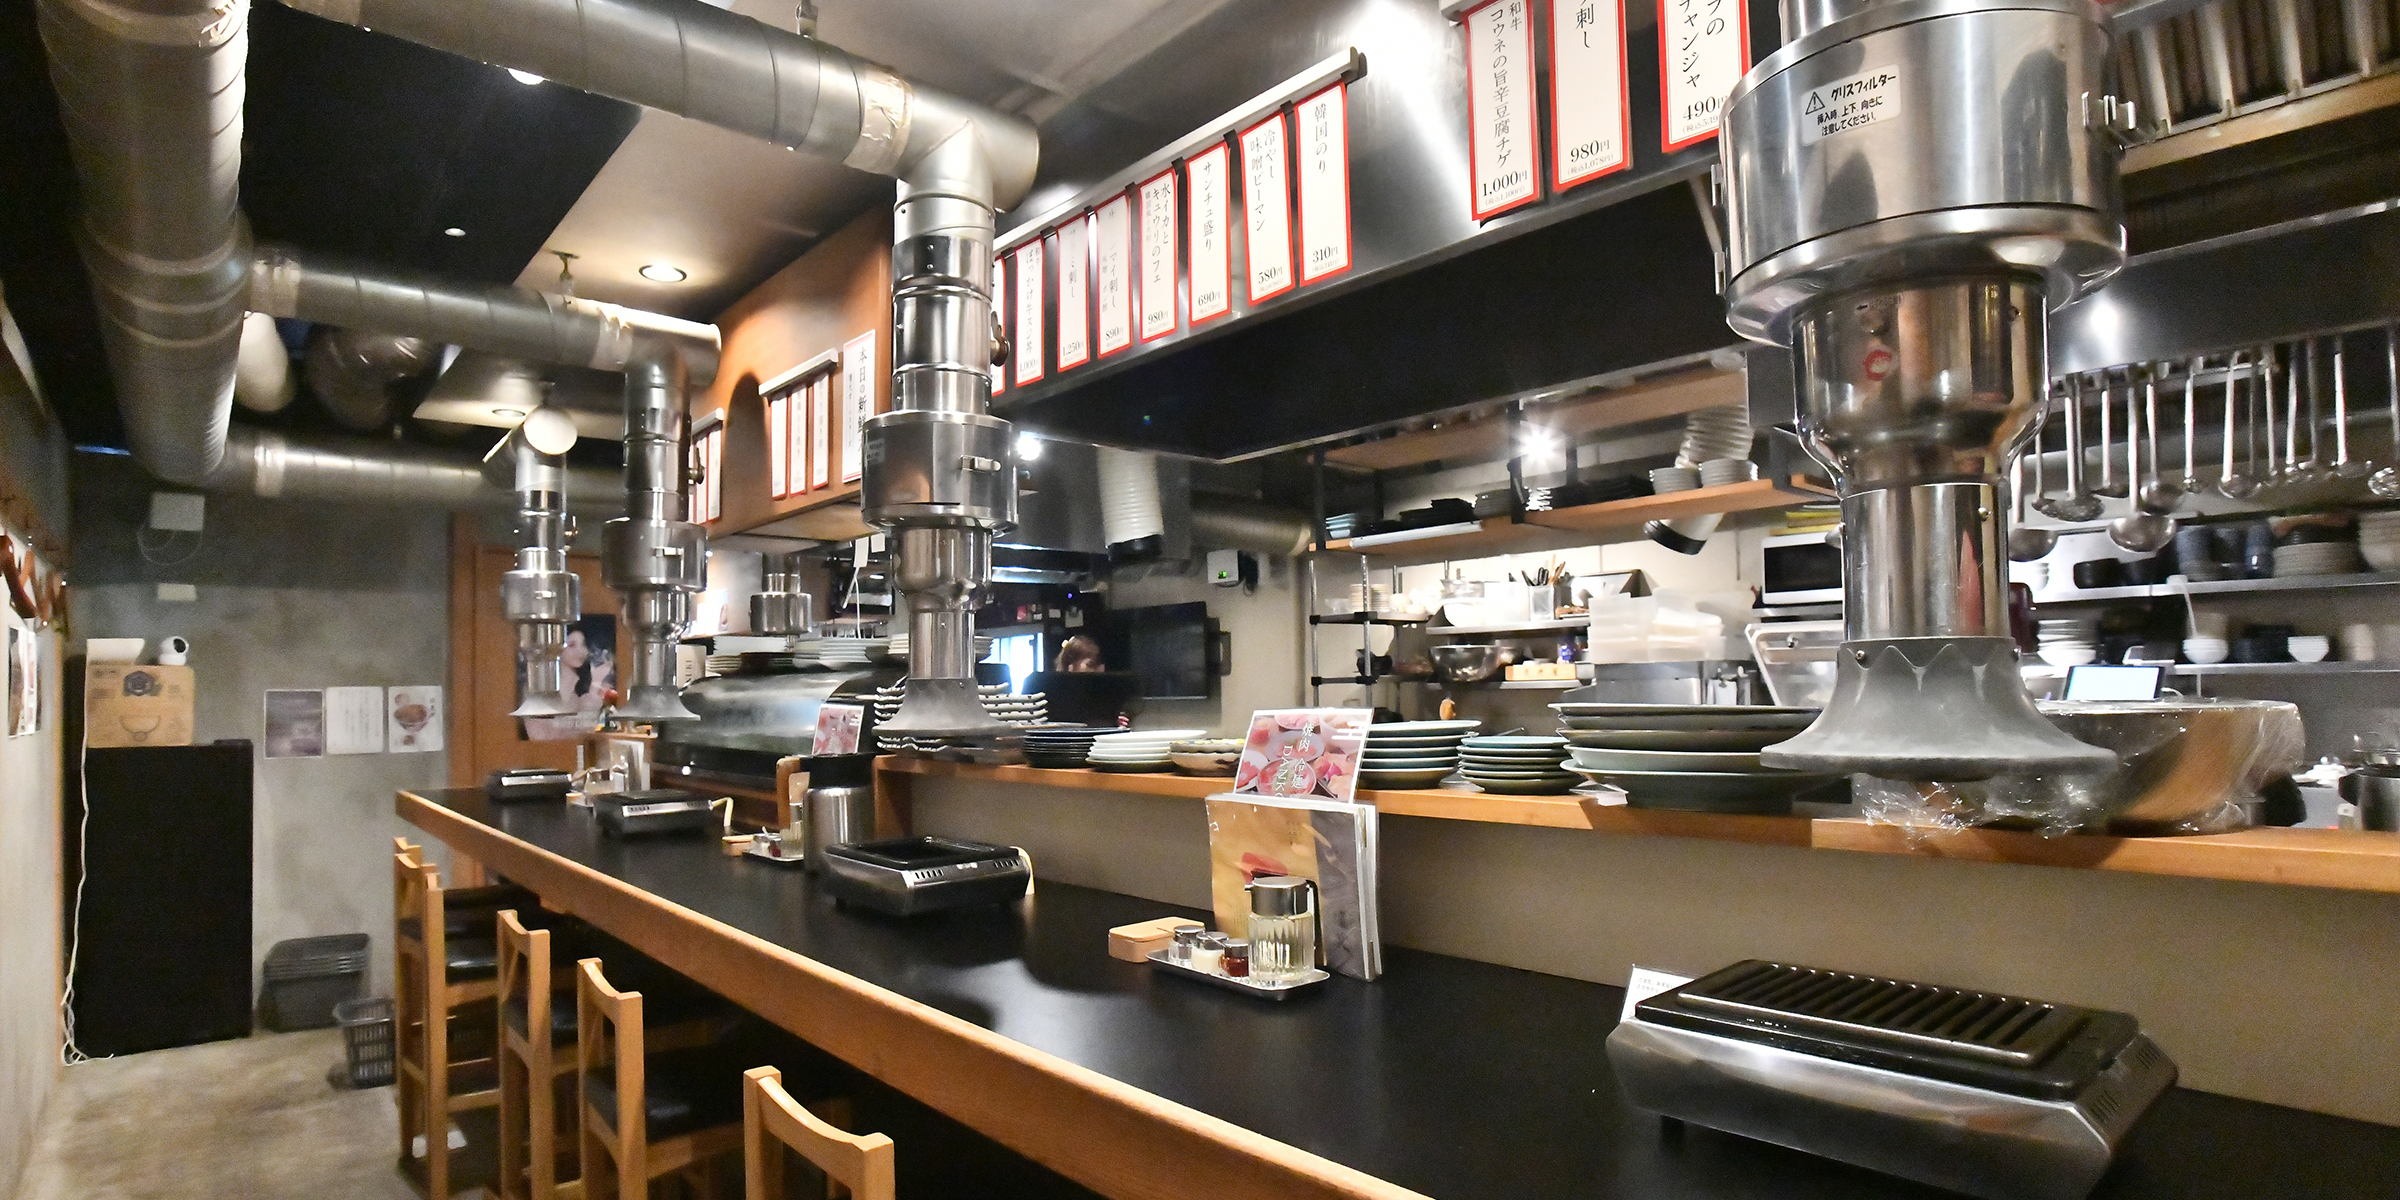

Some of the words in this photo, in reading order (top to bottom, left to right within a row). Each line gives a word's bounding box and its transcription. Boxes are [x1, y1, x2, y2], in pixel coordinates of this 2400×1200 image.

[1510, 2, 1522, 30] 和牛
[1575, 0, 1594, 48] 刺し
[1491, 8, 1512, 168] コウネの旨辛豆腐チゲ
[1830, 74, 1896, 101] グリスフィルター
[1263, 129, 1277, 179] 冷やし
[1314, 103, 1328, 174] 韓国のり
[1570, 139, 1611, 163] 980円
[1203, 161, 1214, 251] サンチュ盛り
[1250, 137, 1265, 232] 味噌ピーマン
[1151, 188, 1161, 283] キュウリのフェ
[1161, 182, 1171, 245] 水イカと
[1258, 267, 1283, 285] 580円
[1312, 246, 1338, 264] 310円
[1198, 291, 1221, 306] 690円
[857, 347, 868, 465] 本日の新鮮
[1298, 722, 1315, 752] 焼肉
